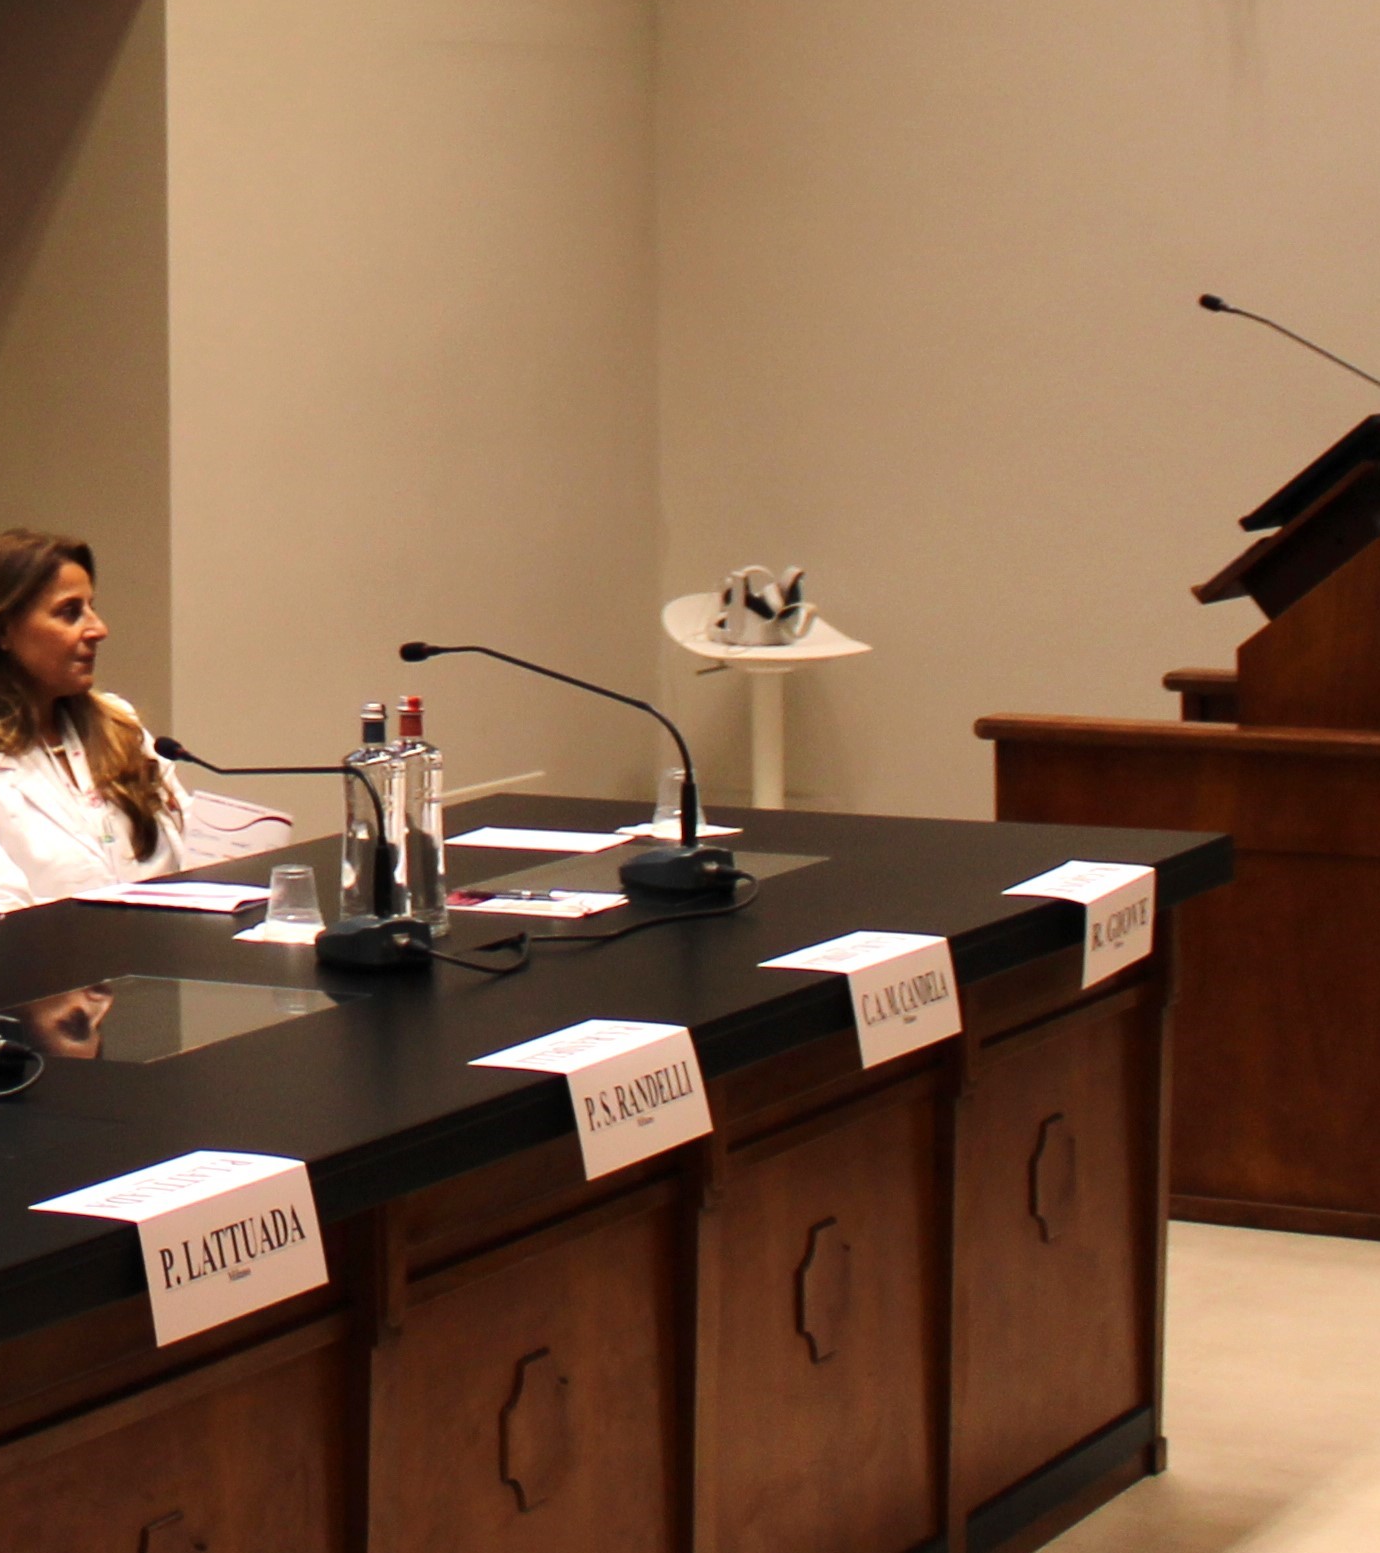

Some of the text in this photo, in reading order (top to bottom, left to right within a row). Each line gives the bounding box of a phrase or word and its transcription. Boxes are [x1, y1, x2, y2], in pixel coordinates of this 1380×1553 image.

[584, 1096, 601, 1131] P.
[614, 1061, 693, 1120] RANDELLI
[159, 1203, 307, 1290] P. LATTUADA
